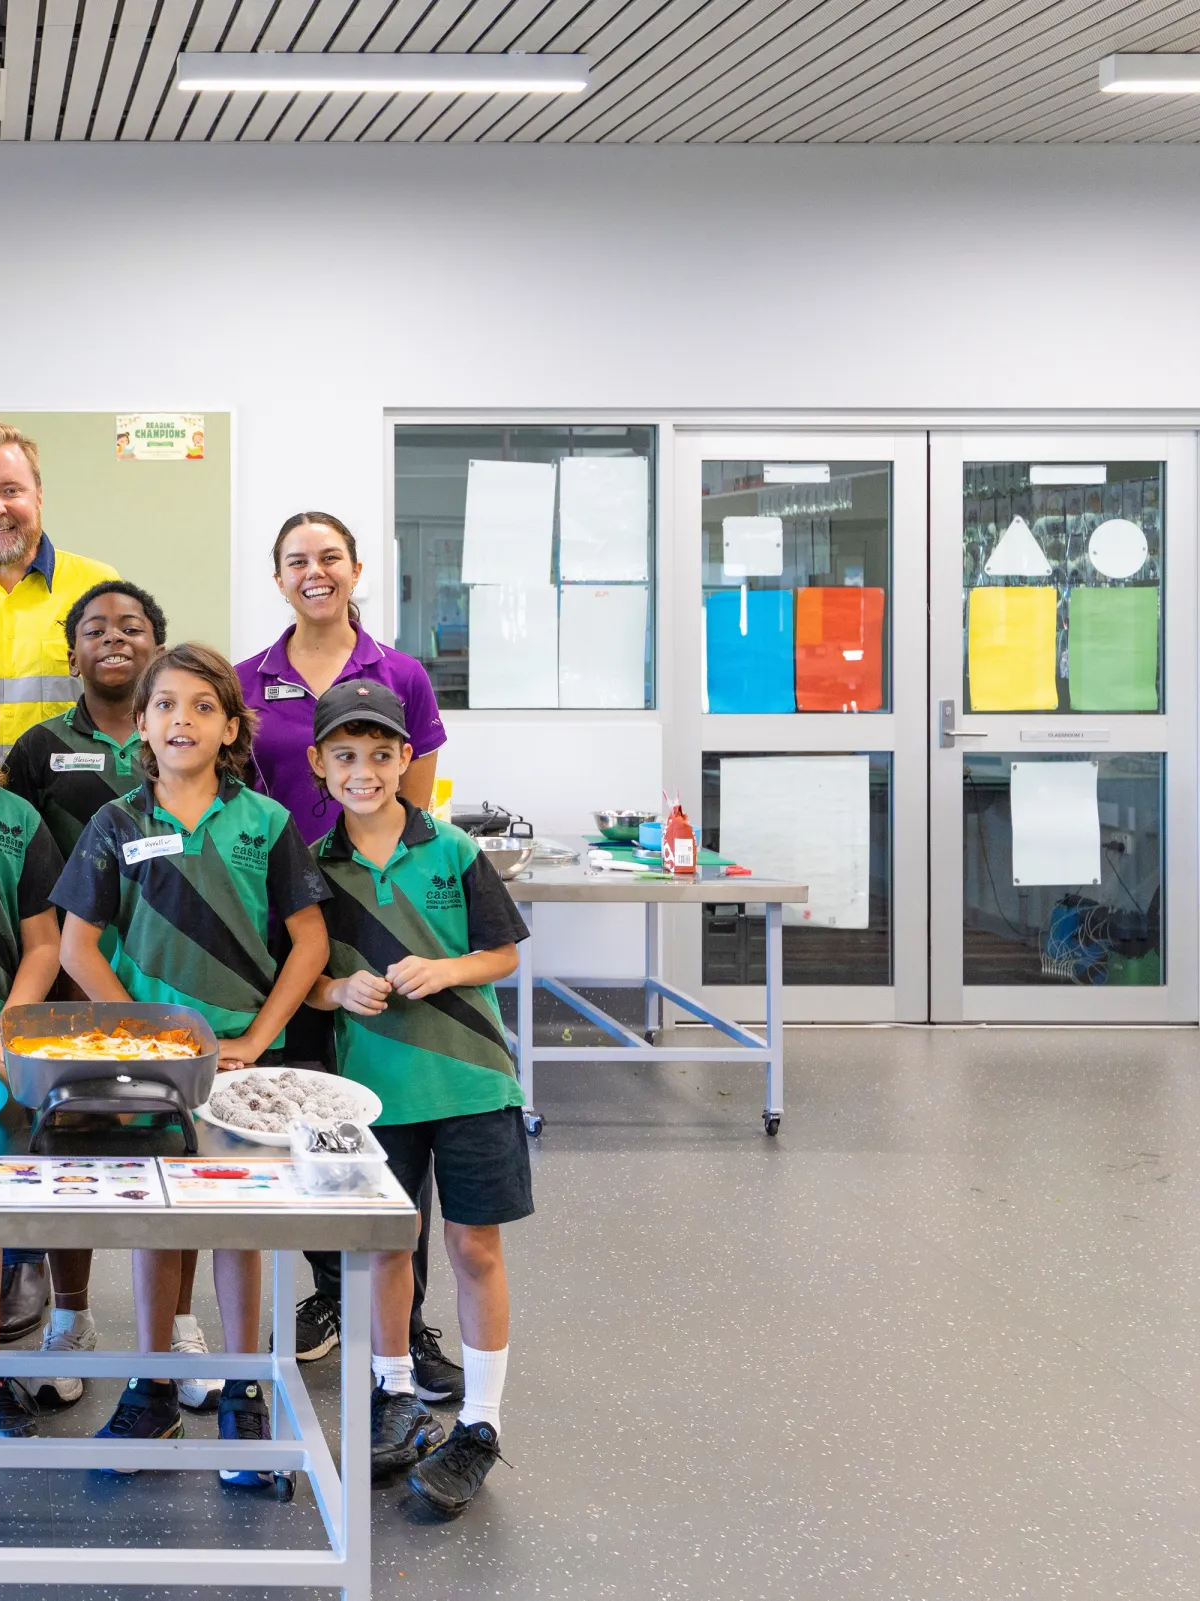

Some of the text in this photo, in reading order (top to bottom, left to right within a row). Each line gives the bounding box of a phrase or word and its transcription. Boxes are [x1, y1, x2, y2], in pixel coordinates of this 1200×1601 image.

[134, 429, 186, 439] CHAMPIONS
[232, 845, 267, 860] cassia
[231, 853, 251, 862] PRIMARY
[426, 890, 461, 899] cassia
